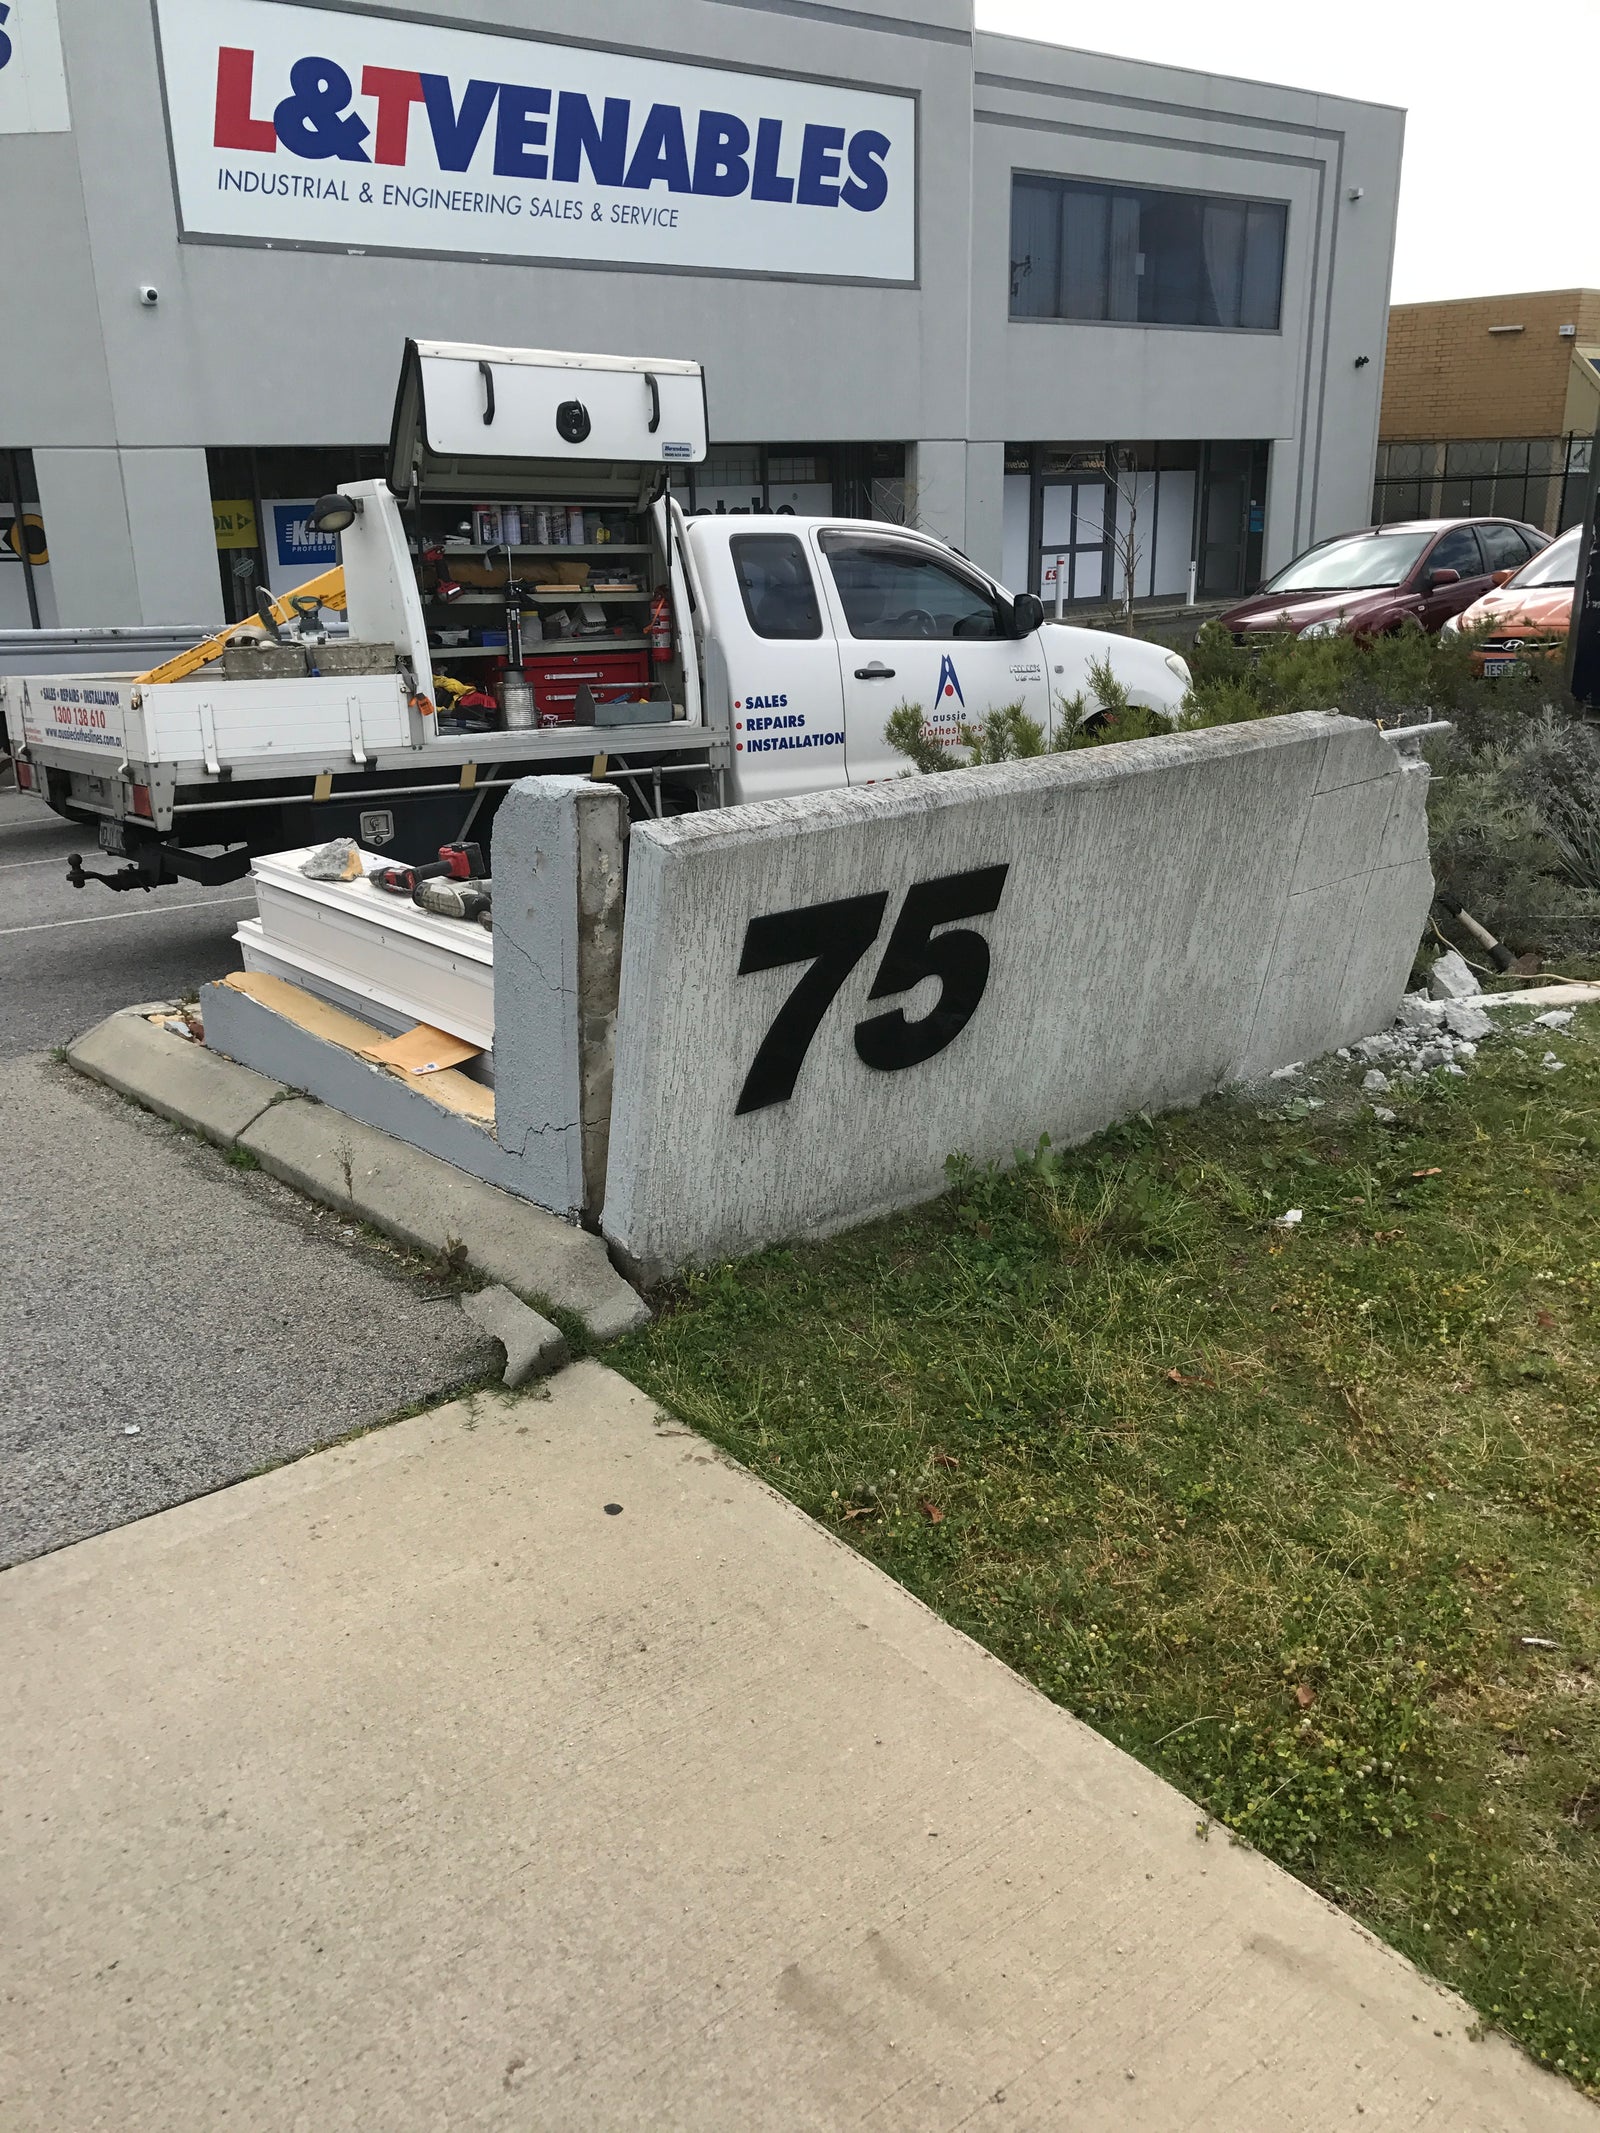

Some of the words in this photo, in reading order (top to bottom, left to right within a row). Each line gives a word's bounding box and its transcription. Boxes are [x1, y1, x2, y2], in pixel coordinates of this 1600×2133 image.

[218, 168, 349, 201] INDUSTRIAL
[358, 182, 374, 204] &
[382, 184, 523, 216] ENGINEERING
[529, 197, 584, 221] SALES
[590, 202, 604, 222] &
[610, 204, 680, 228] SERVICE
[43, 687, 57, 701] SALES
[60, 688, 80, 703] REPAIRS
[83, 690, 120, 706] INSTALLATION
[745, 694, 788, 710] SALES
[53, 705, 72, 724] 1300
[73, 708, 88, 726] 138
[91, 710, 106, 728] 610
[746, 714, 805, 731] REPAIRS
[932, 711, 967, 722] aussie
[45, 727, 122, 748] www.aussieclotheslines.com.a
[919, 724, 984, 738] clothesles
[747, 732, 845, 753] INSTALLATION
[735, 863, 1010, 1116] 75
